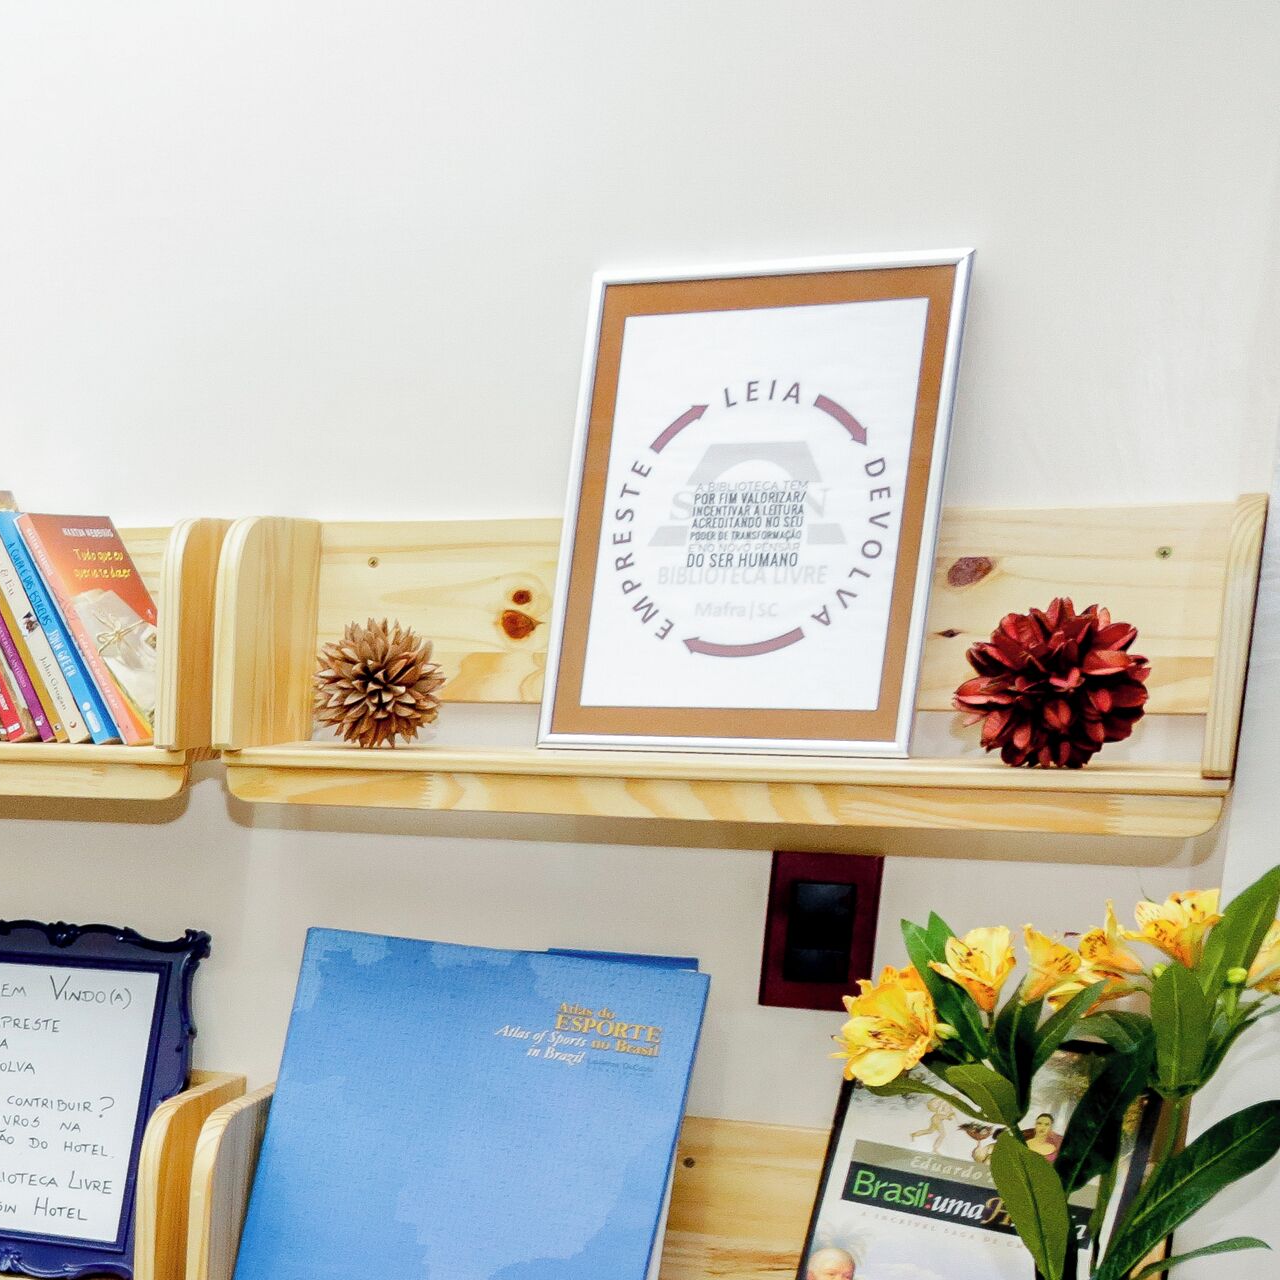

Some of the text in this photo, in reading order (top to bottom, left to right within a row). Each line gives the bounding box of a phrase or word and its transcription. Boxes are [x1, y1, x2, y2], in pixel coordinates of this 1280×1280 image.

[724, 379, 800, 408] LEIA
[694, 491, 806, 505] POR FIM VALORIZAR/
[692, 504, 804, 516] INCENTIVAR A LEITURA
[692, 516, 804, 529] ACREDITANDO NO SEU
[6, 540, 15, 548] A
[689, 528, 802, 542] PODER DE TRANSFORMAÇÃO
[811, 456, 892, 627] DEVOLVA
[10, 548, 24, 567] CULPA
[612, 459, 676, 640] EMPRESTE
[686, 552, 799, 568] DO SER HUMANO
[4, 578, 18, 595] Eu
[22, 575, 35, 589] DAS
[27, 589, 52, 626] ESTRELAS
[46, 628, 78, 677] JOHN GREEN
[495, 1025, 587, 1048] Atlas of Sports
[554, 1013, 663, 1044] ESPORTE
[527, 1044, 586, 1067] in Brazil
[591, 1039, 659, 1057] no Brasil
[60, 1121, 81, 1133] NA
[29, 1137, 48, 1149] DO
[910, 1155, 983, 1181] Eduardo
[68, 1170, 114, 1194] LIVRE
[852, 1170, 984, 1220] Brasil: uma
[34, 1196, 88, 1221] HOTEL
